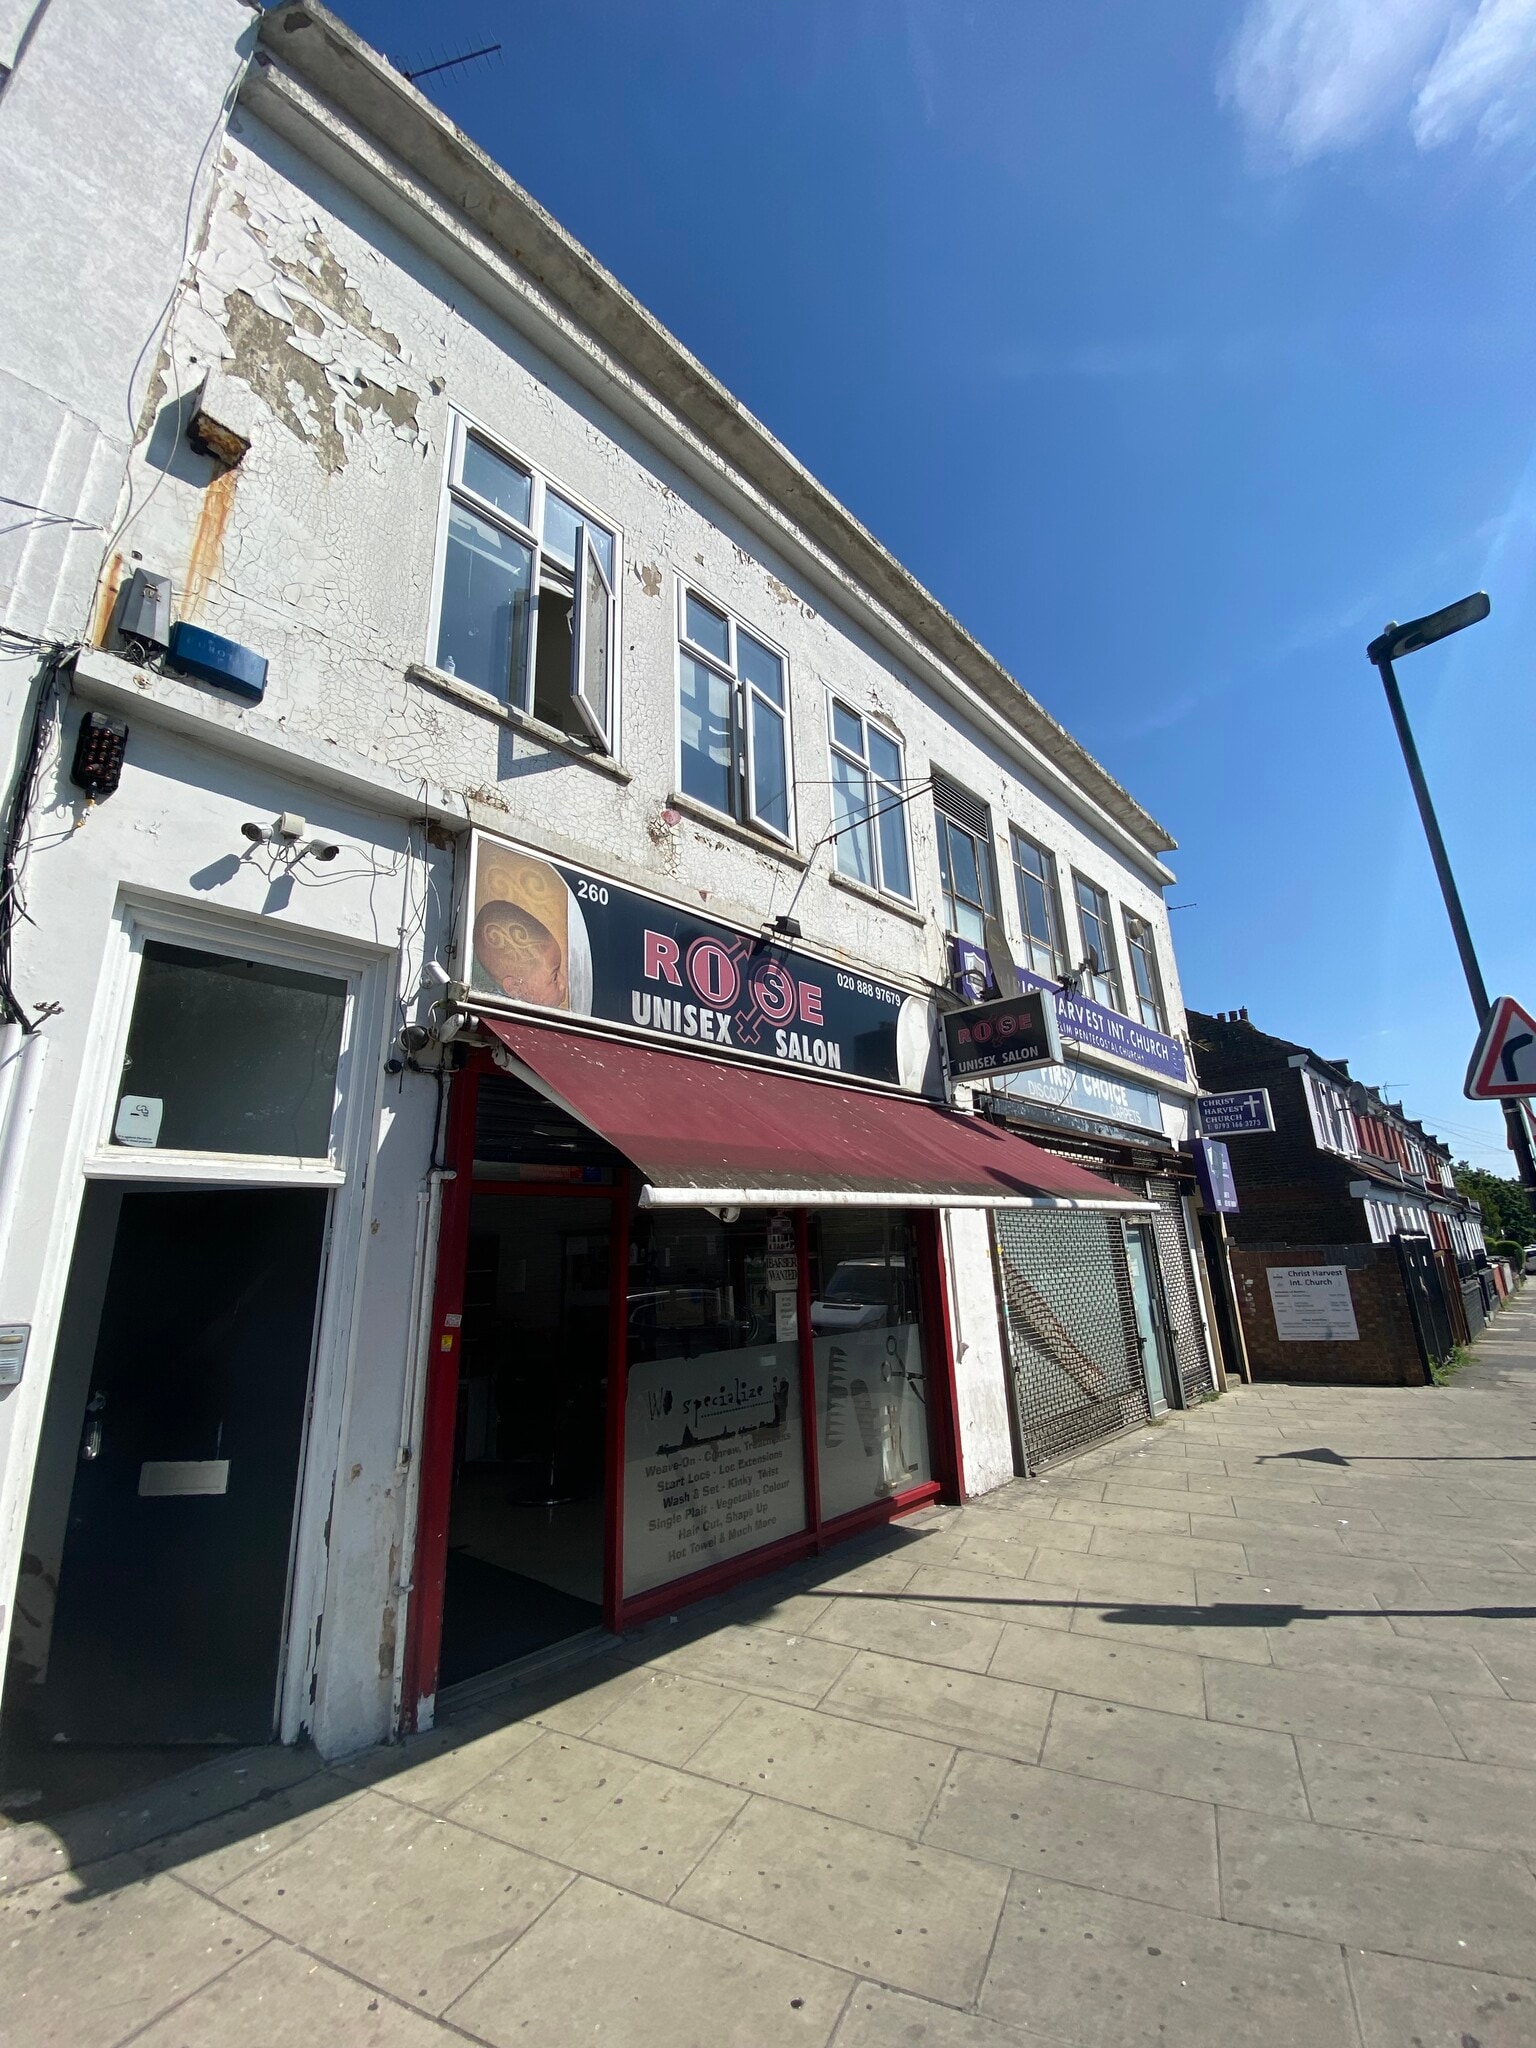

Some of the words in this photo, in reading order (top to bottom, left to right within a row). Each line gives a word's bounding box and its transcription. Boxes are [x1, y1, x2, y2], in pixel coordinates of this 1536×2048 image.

[577, 879, 609, 906] 260
[837, 972, 855, 991] 020
[857, 980, 874, 998] 888
[875, 986, 901, 1007] 97679
[631, 989, 733, 1045] UNISEX
[775, 1027, 841, 1070] SALON
[1053, 996, 1104, 1031] ARVEST
[1130, 1030, 1169, 1061] CHURCH
[1075, 1027, 1118, 1053] PENTECOSTAL
[1119, 1045, 1140, 1061] CHURCH
[958, 1055, 996, 1072] UNISEX
[1002, 1045, 1039, 1064] SALON
[1028, 1080, 1073, 1106] DISCOUNT
[1110, 1104, 1142, 1124] CARPETS
[1040, 1065, 1078, 1091] FIRST
[1082, 1070, 1128, 1106] CHOICE
[1203, 1098, 1234, 1106] CHRIST
[1204, 1106, 1244, 1114] HARVEST
[1206, 1114, 1242, 1124] CHURCH
[1214, 1122, 1230, 1130] 0793
[768, 1270, 797, 1280] WANTED
[683, 1378, 764, 1428] specialize
[645, 1457, 696, 1479] Weave-On
[658, 1477, 684, 1492] Start
[688, 1470, 710, 1484] Locs
[719, 1463, 735, 1474] Loc
[738, 1450, 783, 1469] Extensions
[648, 1513, 682, 1532] Single
[685, 1504, 708, 1520] Plait
[716, 1488, 760, 1510] Vegetable
[762, 1479, 790, 1494] Colour
[662, 1492, 690, 1509] Wash
[693, 1490, 700, 1500] &
[702, 1484, 720, 1497] Set
[728, 1474, 753, 1490] Kinky
[758, 1467, 779, 1480] Twist
[668, 1548, 687, 1562] Hot
[690, 1536, 716, 1554] Towel
[720, 1532, 726, 1544] &
[728, 1524, 752, 1541] Much
[755, 1516, 776, 1530] More
[678, 1525, 700, 1540] Hair
[726, 1508, 754, 1524] Shape
[756, 1503, 768, 1514] Up
